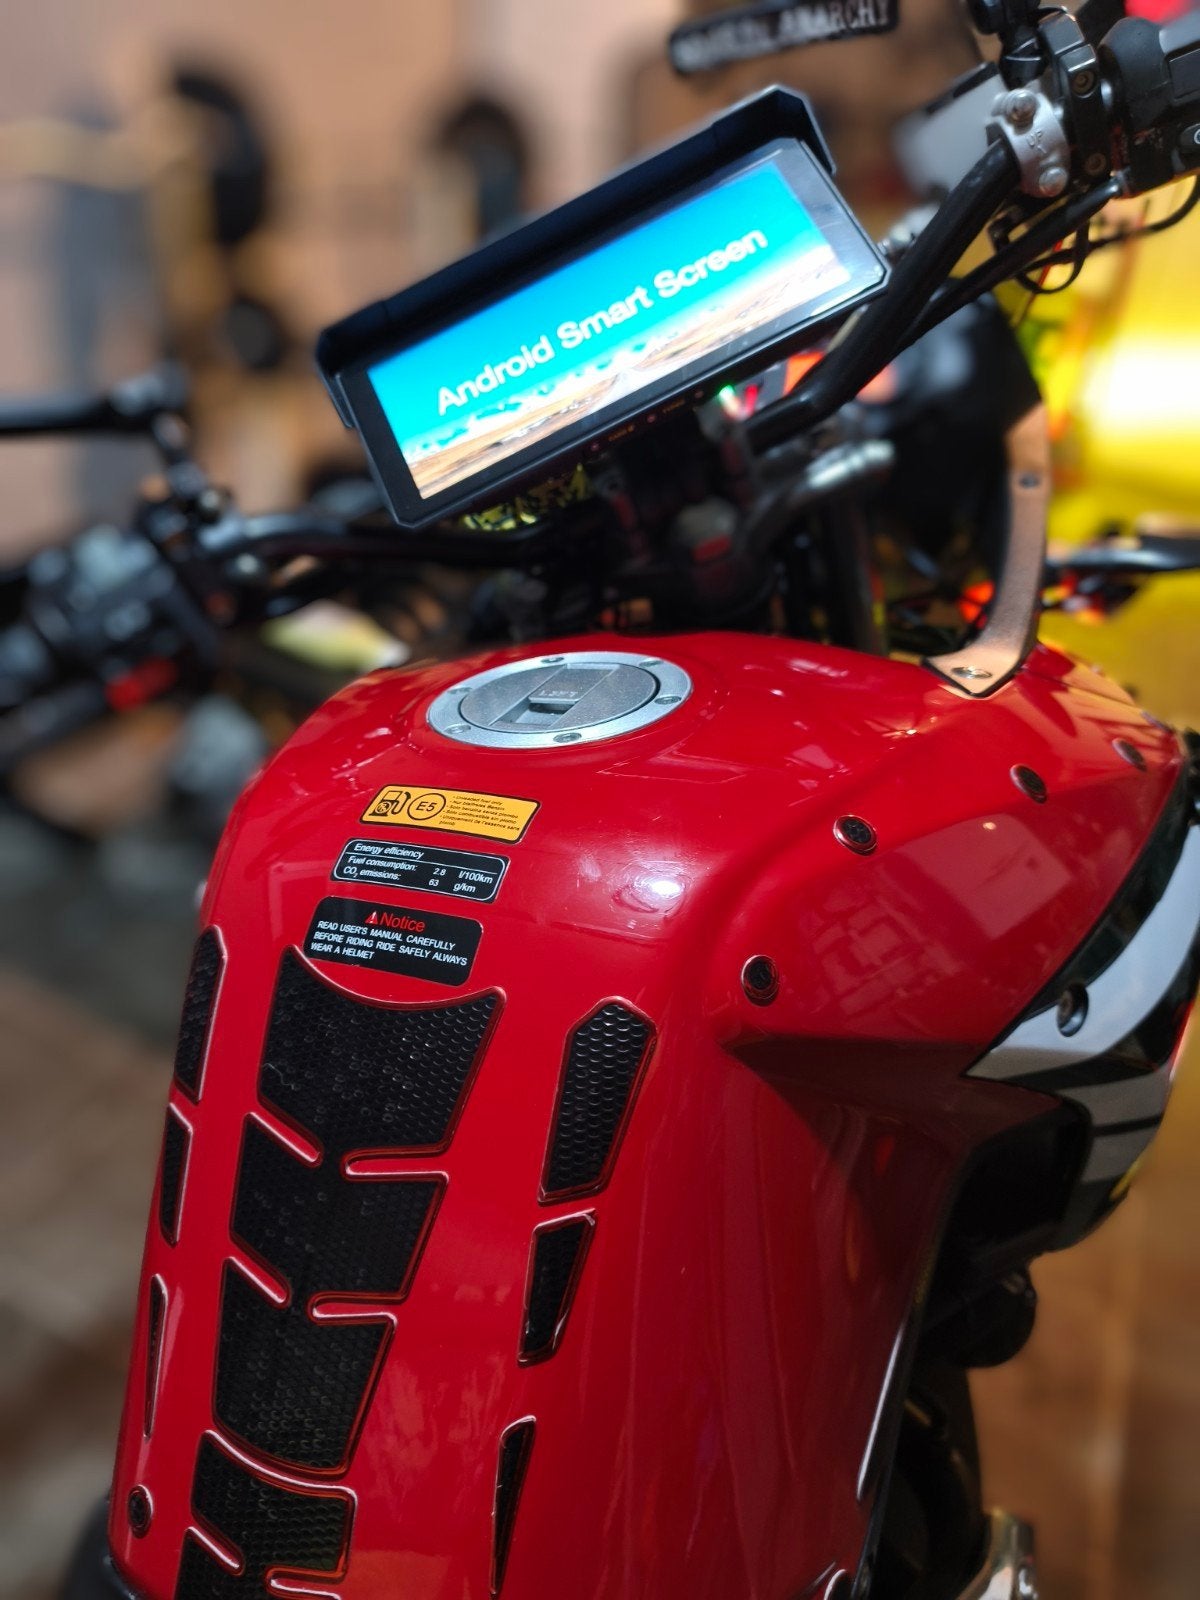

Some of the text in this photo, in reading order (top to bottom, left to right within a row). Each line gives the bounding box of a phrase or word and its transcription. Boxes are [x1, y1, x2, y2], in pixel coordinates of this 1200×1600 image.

[438, 229, 769, 416] Android Smart Screen
[416, 801, 438, 812] E5
[354, 843, 424, 860] Energy efficiency
[347, 856, 366, 864] Fuel
[366, 858, 418, 872] consumption:
[433, 868, 447, 876] 2.8
[360, 869, 402, 880] emissions:
[429, 878, 440, 887] 63
[453, 882, 476, 893] g/km
[380, 912, 426, 933] Notice
[317, 920, 455, 950] READ USER'S MANUAL CAREFULLY
[311, 942, 375, 960] WEAR A HELMET
[313, 931, 468, 966] BEFORE RIDING RIDE SAFELY ALWAYS
